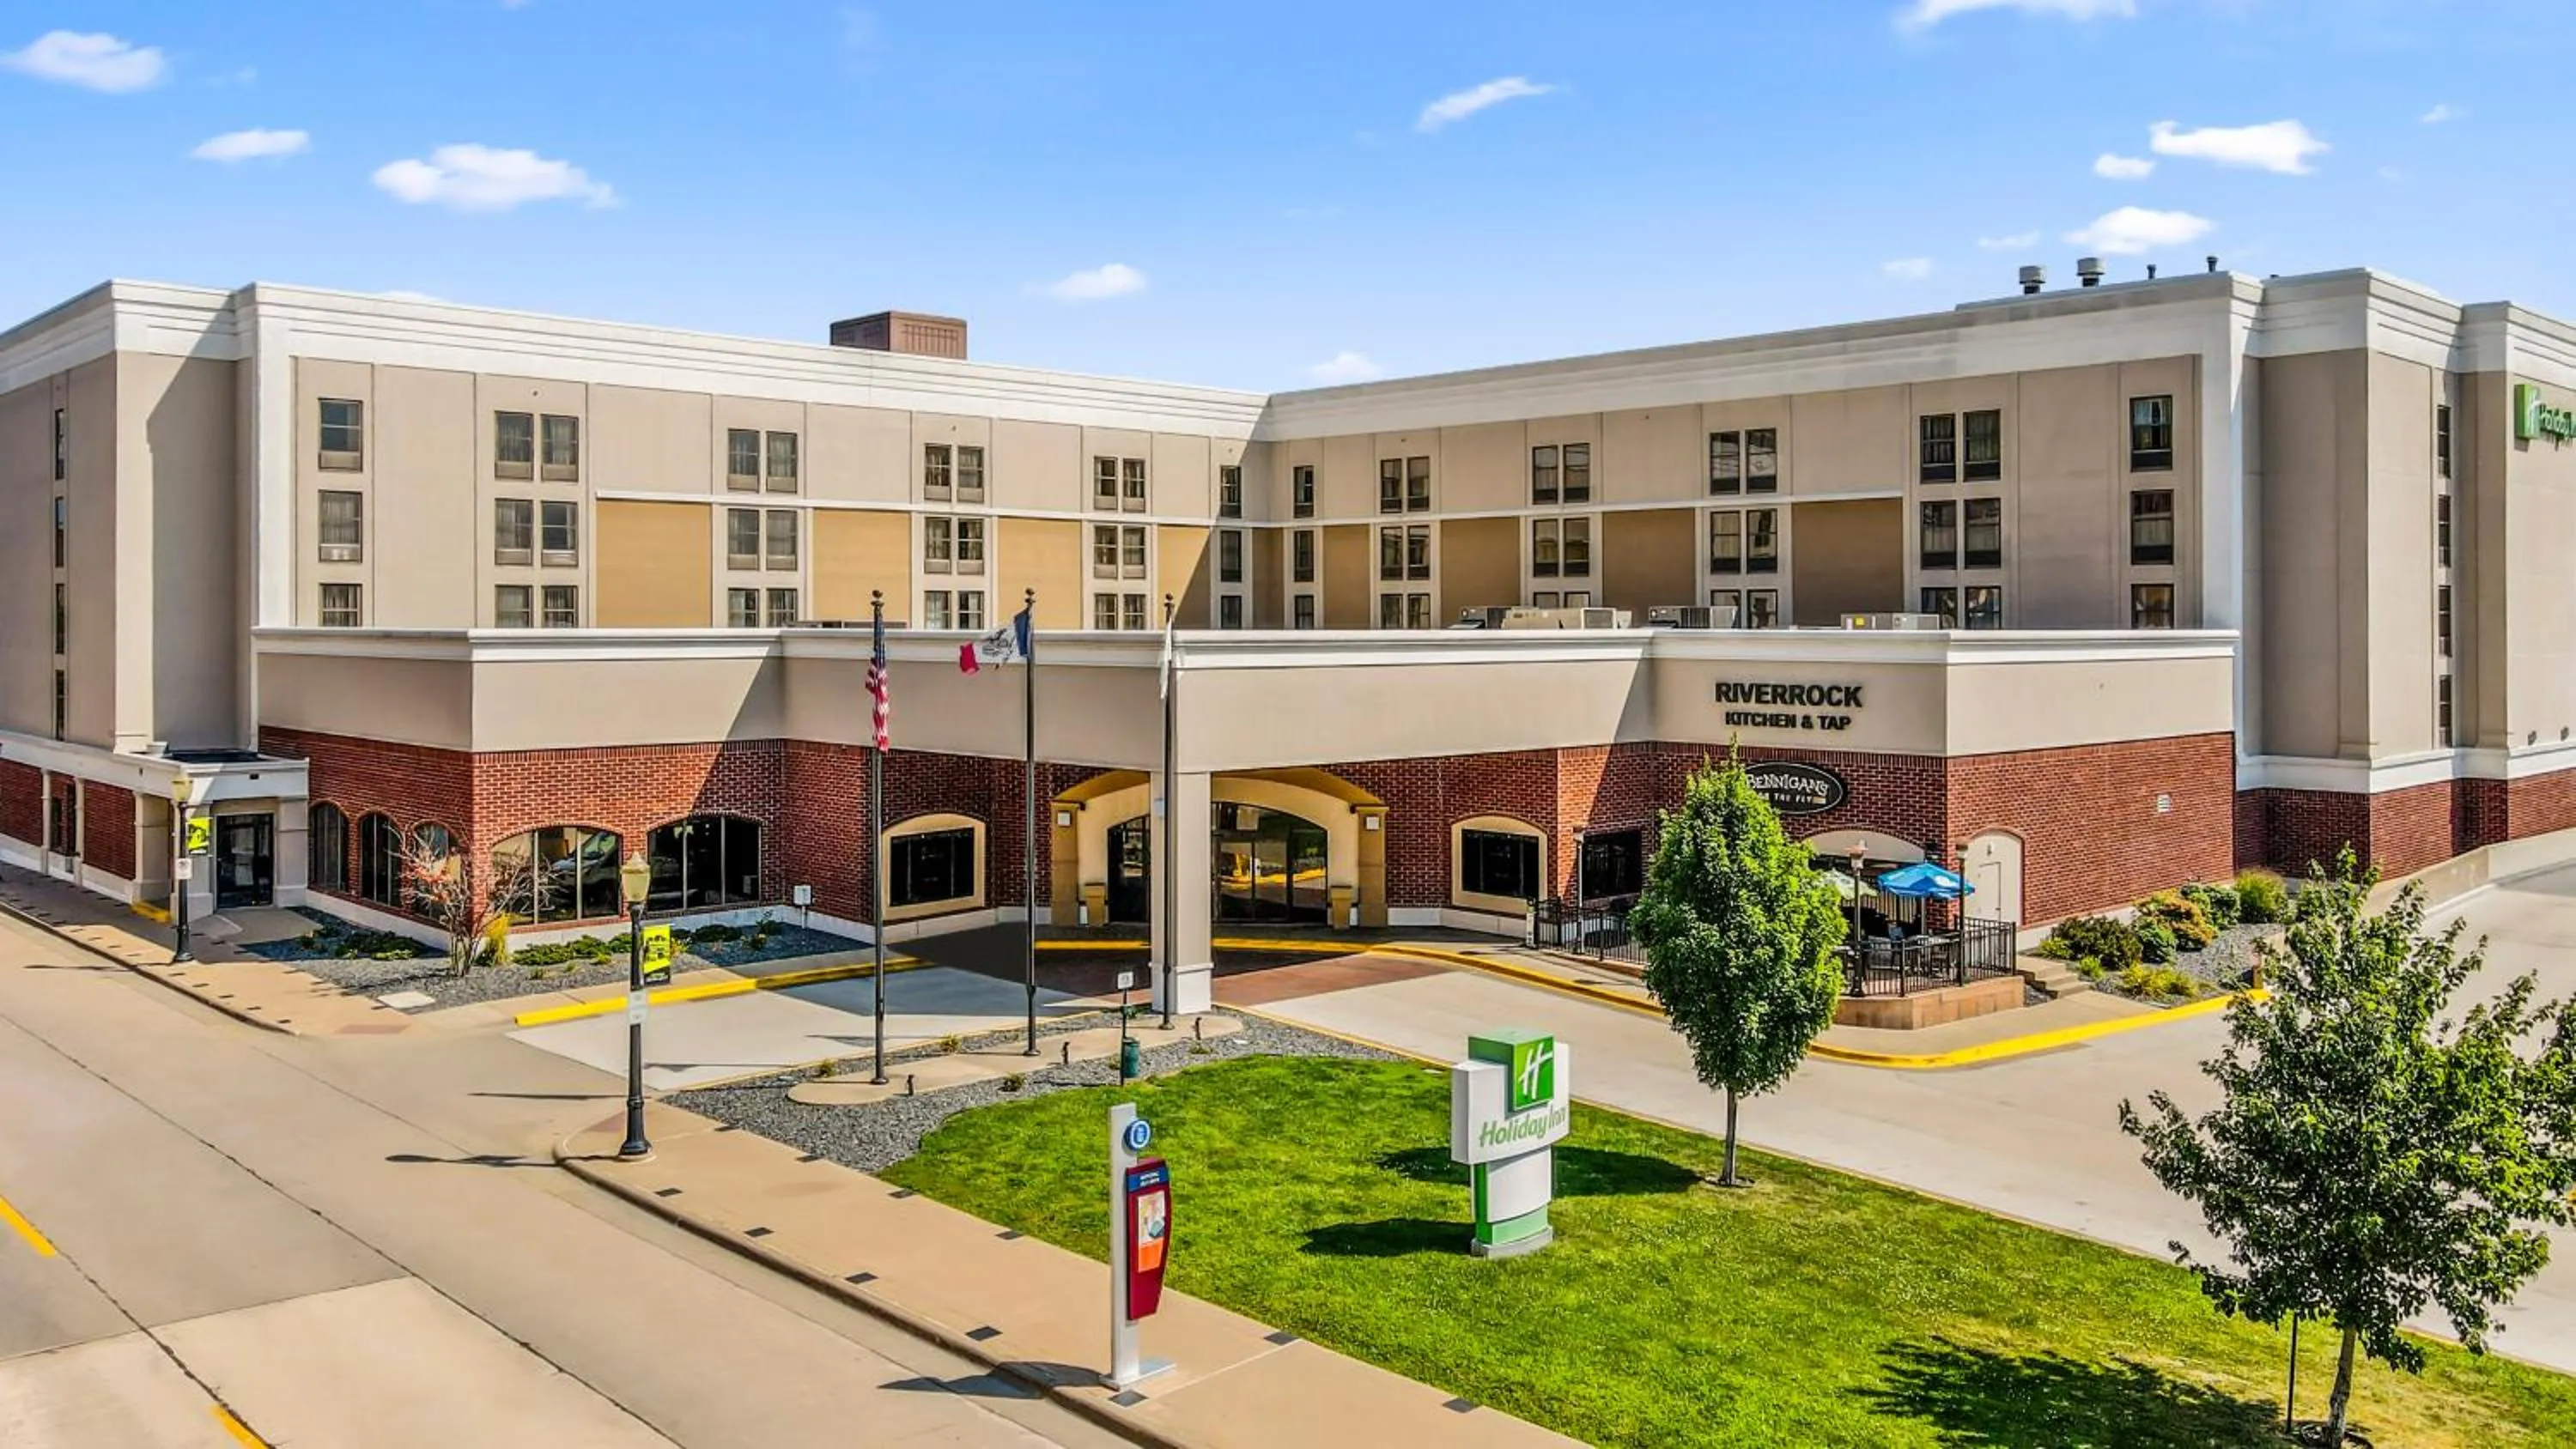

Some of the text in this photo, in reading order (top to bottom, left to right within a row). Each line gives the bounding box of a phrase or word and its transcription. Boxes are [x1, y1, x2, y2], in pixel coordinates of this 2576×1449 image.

[1715, 682, 1862, 708] RIVERROCK
[1725, 712, 1851, 730] KITCHEN & TAP
[1479, 1104, 1566, 1147] Holiday Inn
